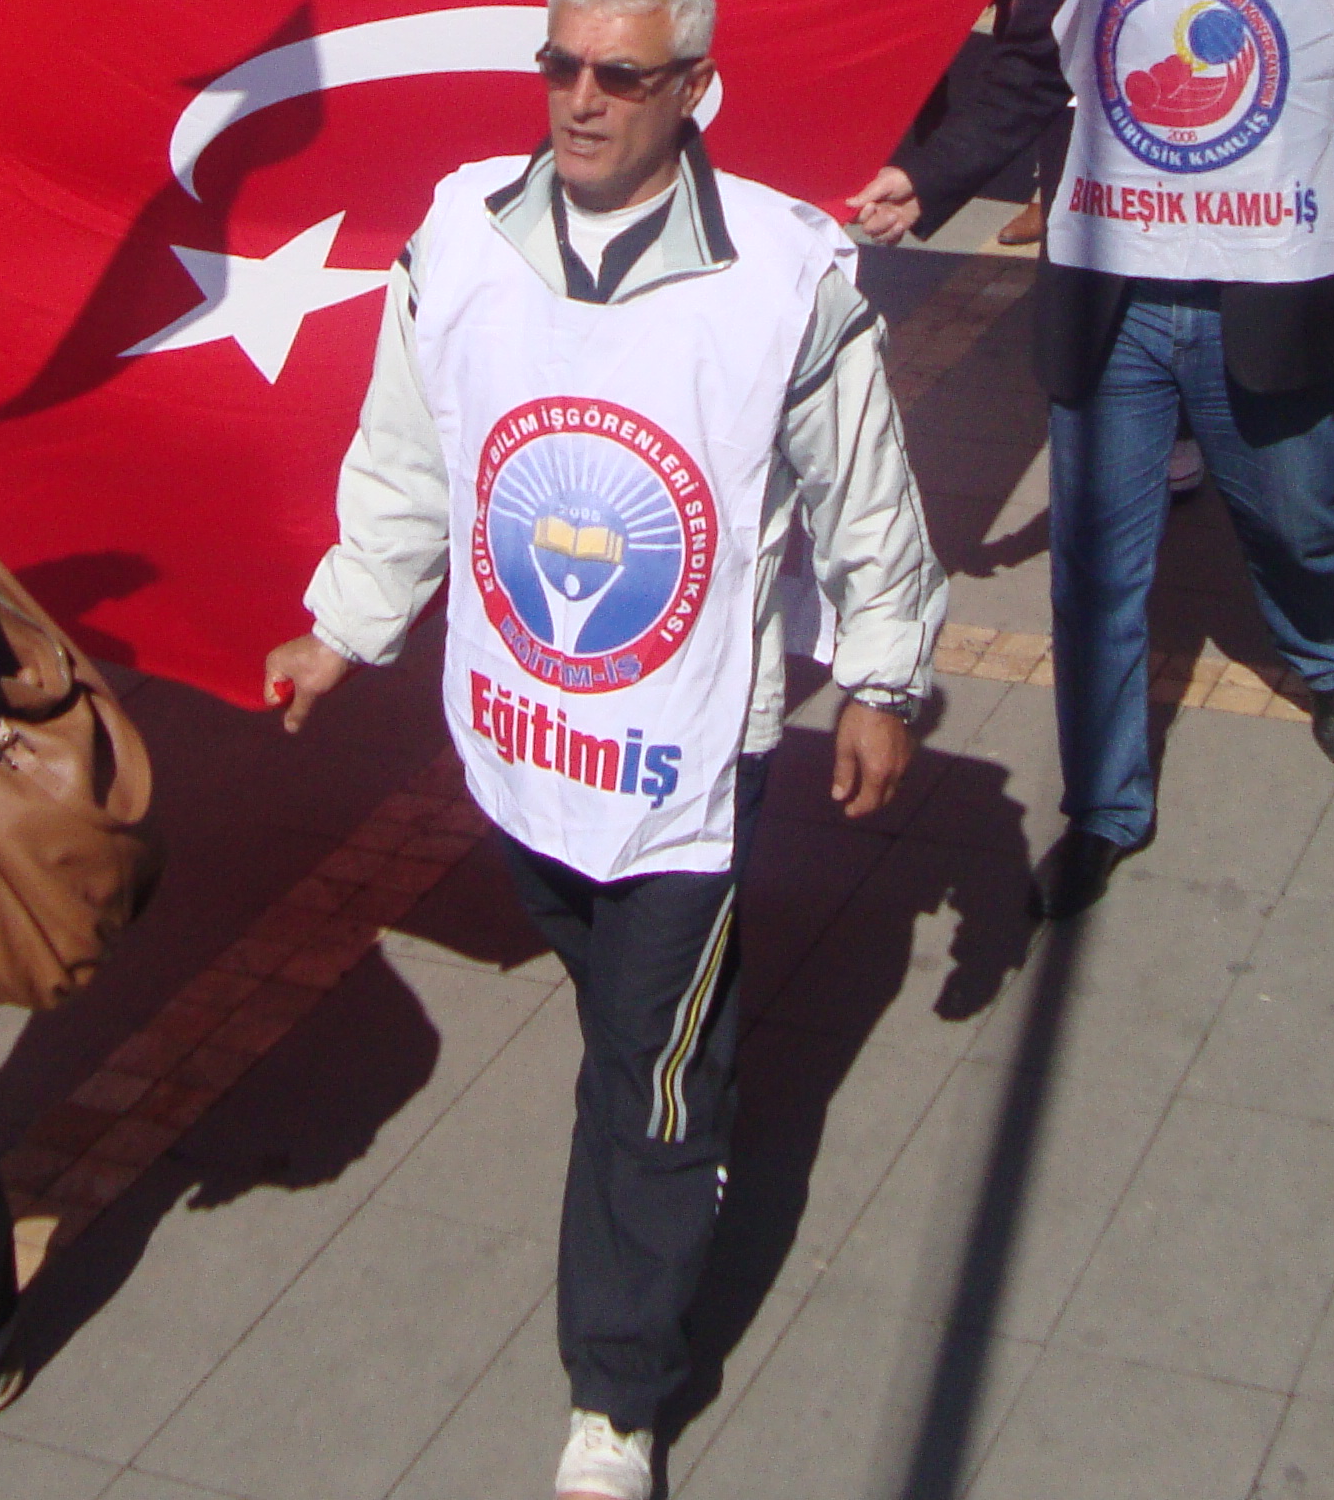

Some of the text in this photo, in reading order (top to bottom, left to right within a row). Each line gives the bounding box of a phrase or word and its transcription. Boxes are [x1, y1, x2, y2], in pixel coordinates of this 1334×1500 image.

[1069, 177, 1318, 234] BİRLEŞİK KAMU-İŞ
[490, 413, 539, 465] BİLİM
[540, 404, 699, 497] İŞGÖRENLERİ
[659, 499, 707, 642] SENDİKASI
[499, 615, 643, 688] EĞİTİM-İŞ
[470, 669, 683, 809] Eğitimiş
